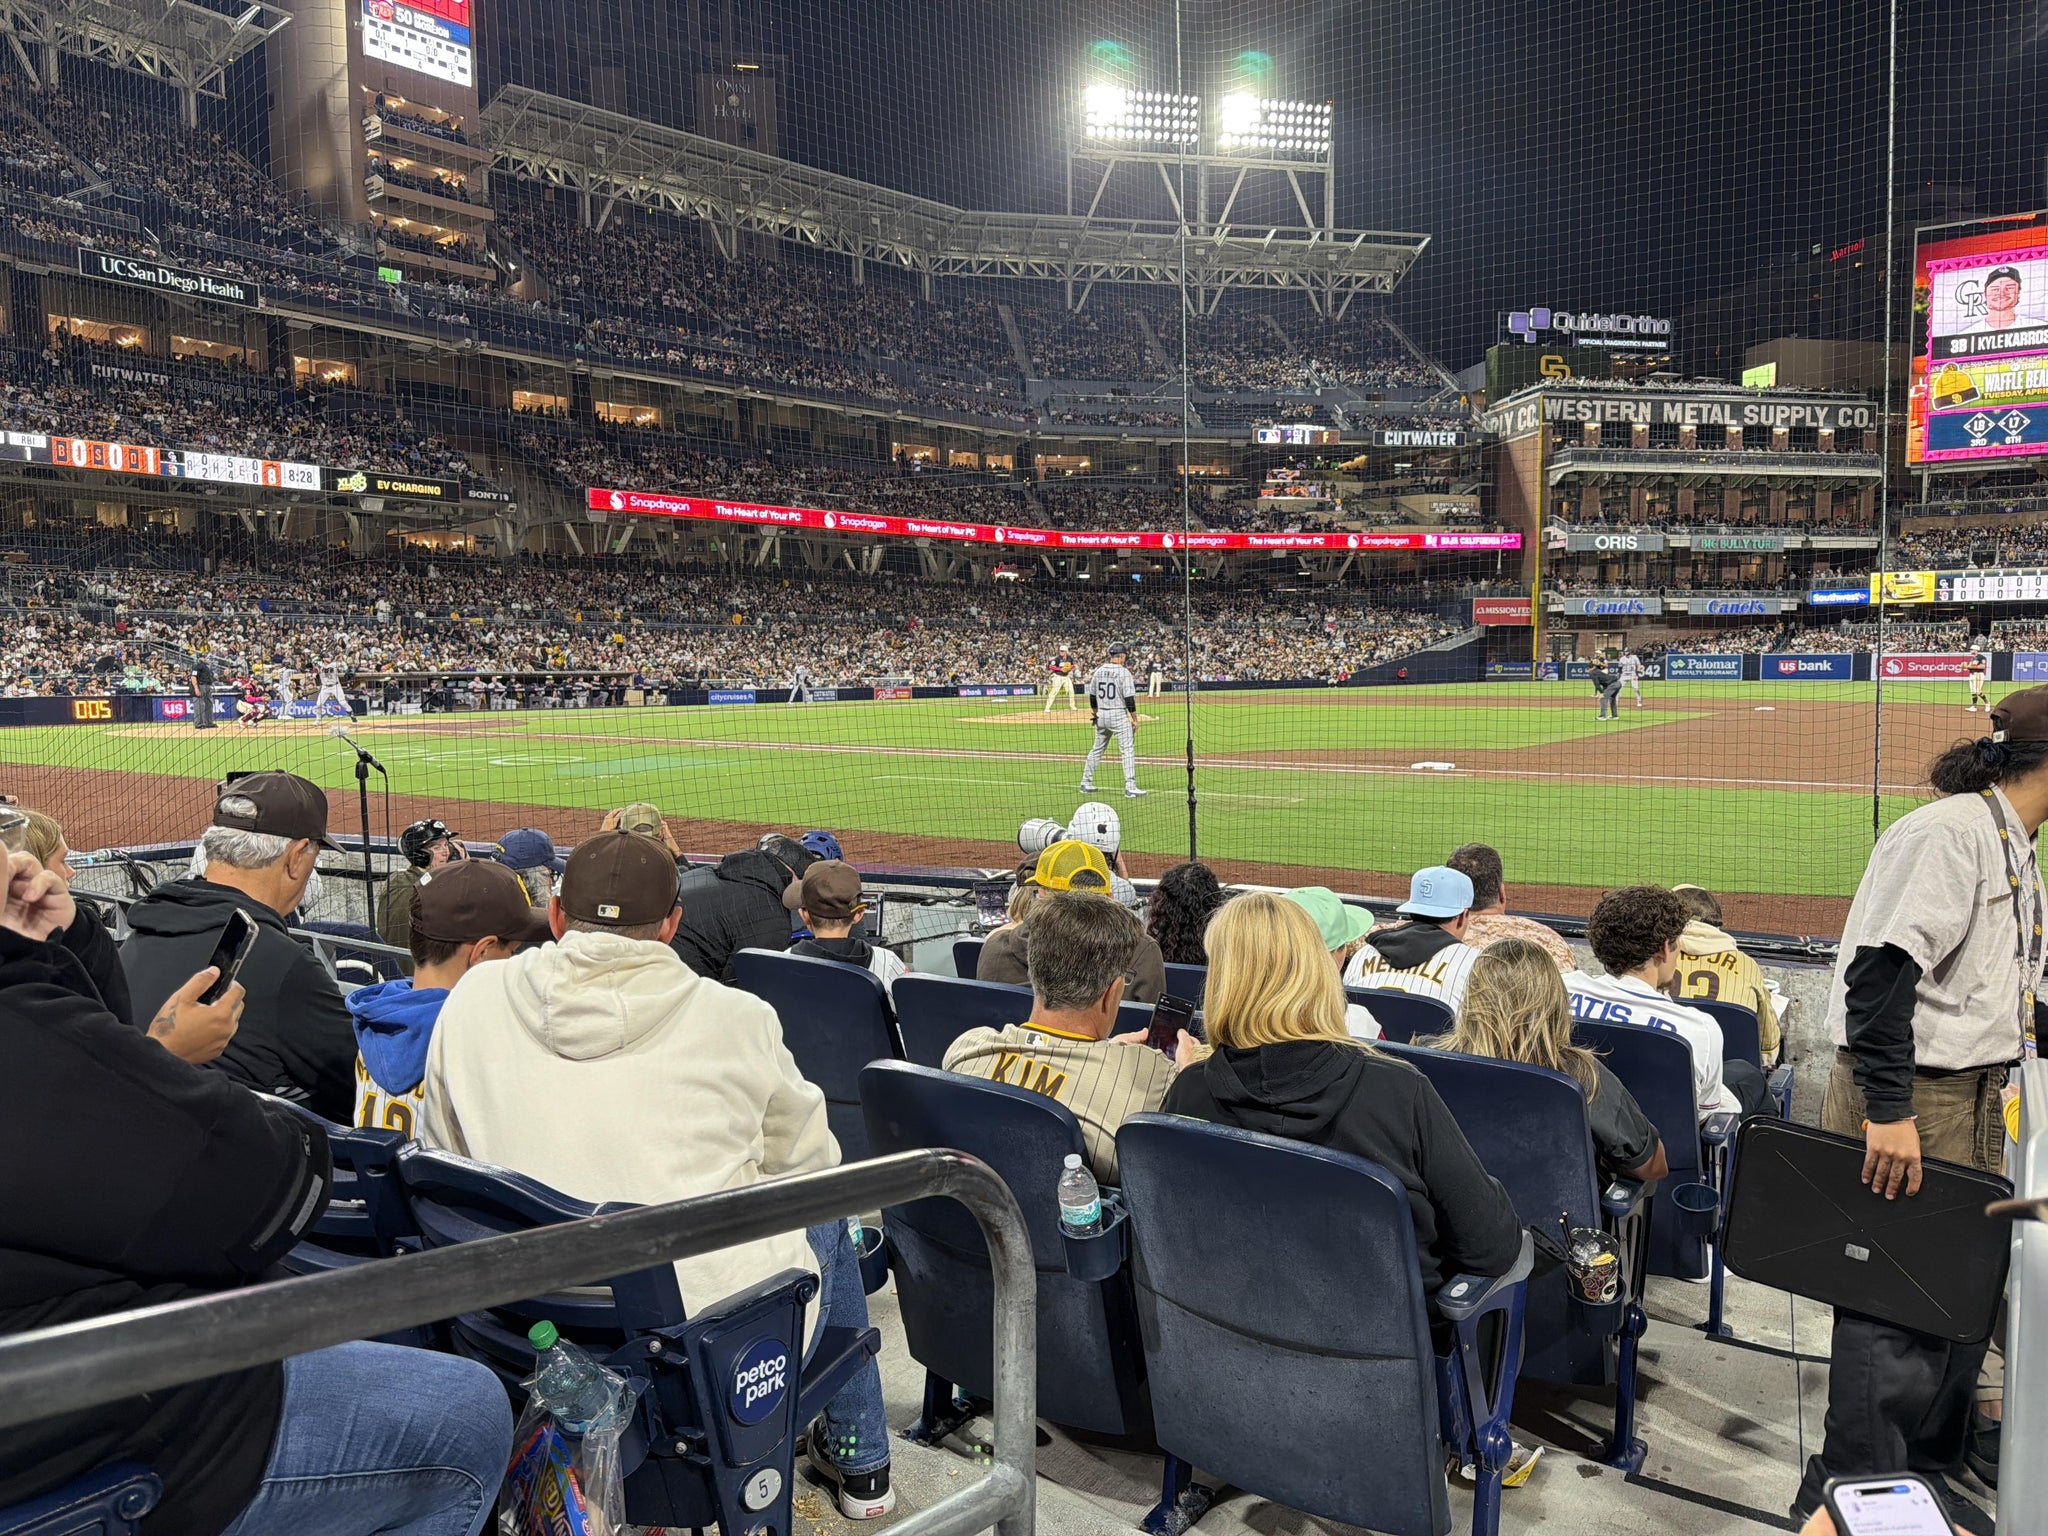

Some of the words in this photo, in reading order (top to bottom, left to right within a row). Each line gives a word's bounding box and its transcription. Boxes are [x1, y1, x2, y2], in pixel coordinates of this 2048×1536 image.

[396, 6, 412, 25] 50
[716, 79, 750, 94] OMNI
[100, 256, 126, 276] UC
[128, 262, 156, 283] San
[158, 268, 198, 293] Diego
[199, 276, 245, 300] Health
[1554, 312, 1671, 334] QuidelOrtho
[1977, 334, 2003, 350] KYLE
[1984, 370, 2023, 392] WAFFLE
[1984, 390, 2024, 400] TUESDAY,
[1518, 404, 1539, 432] CO.
[1544, 398, 1650, 422] WESTERN
[1663, 402, 1738, 424] METAL
[1744, 404, 1830, 427] SUPPLY
[1838, 407, 1874, 429] CO.
[21, 434, 35, 446] RBI
[1384, 430, 1456, 446] CUTWATER
[25, 446, 32, 461] 1
[58, 444, 66, 457] B
[71, 439, 87, 467] 0
[94, 450, 102, 461] S
[109, 443, 123, 470] 0
[145, 447, 155, 474] 1
[186, 460, 193, 471] R
[202, 454, 208, 466] 0
[213, 462, 219, 474] H
[227, 457, 234, 468] 5
[239, 466, 244, 476] E
[252, 460, 258, 471] 0
[288, 469, 313, 484] 8:28
[202, 468, 208, 478] 2
[228, 469, 234, 481] 4
[253, 472, 259, 484] 0
[376, 480, 390, 491] EV
[392, 482, 442, 496] CHARGING
[468, 489, 499, 500] SONY
[630, 496, 690, 512] Snapdragon
[715, 505, 733, 516] The
[734, 507, 758, 518] Heart
[759, 510, 768, 519] of
[770, 511, 788, 521] Your
[789, 512, 802, 522] PC
[840, 515, 887, 530] Snapdragon
[907, 522, 921, 532] The
[921, 523, 941, 533] Heart
[942, 524, 950, 533] of
[950, 525, 965, 536] Your
[965, 526, 976, 537] PC
[1007, 530, 1046, 544] Snapdragon
[1061, 535, 1077, 544] The
[1077, 536, 1099, 544] Heart
[1100, 536, 1109, 544] of
[1110, 536, 1127, 544] Your
[1128, 536, 1140, 544] PC
[1248, 536, 1263, 544] The
[1264, 536, 1284, 545] Heart
[1285, 536, 1294, 544] of
[1294, 537, 1312, 545] Your
[1313, 537, 1324, 545] PC
[1363, 537, 1410, 547] Snapdragon
[1594, 536, 1638, 550] ORIS
[1701, 538, 1717, 548] BIG
[1720, 538, 1750, 548] BULLY
[1961, 579, 1966, 588] 0
[1980, 578, 1985, 588] 0
[1998, 578, 2003, 587] 0
[2017, 577, 2022, 586] 0
[2036, 577, 2041, 586] 0
[1812, 592, 1860, 602] Southwest
[1960, 590, 1966, 600] 0
[1979, 590, 1984, 599] 0
[1997, 590, 2003, 599] 0
[2016, 589, 2022, 598] 0
[2035, 588, 2040, 598] 2
[1486, 606, 1516, 614] MISSION
[1583, 599, 1644, 615] Canel's
[1707, 600, 1766, 615] Canel's
[1546, 616, 1568, 630] 336
[1638, 665, 1661, 678] 342
[1687, 658, 1738, 669] Palomar
[1908, 662, 1963, 673] Snapdrag
[710, 694, 747, 702] citycruises
[1098, 682, 1116, 700] 50
[74, 700, 112, 720] 005
[1362, 955, 1448, 984] MELL
[1706, 952, 1738, 975] JR.
[1570, 992, 1632, 1024] ATIS
[991, 1050, 1068, 1099] KIM
[736, 1354, 786, 1394] petco
[745, 1371, 785, 1408] park
[758, 1478, 768, 1499] 5
